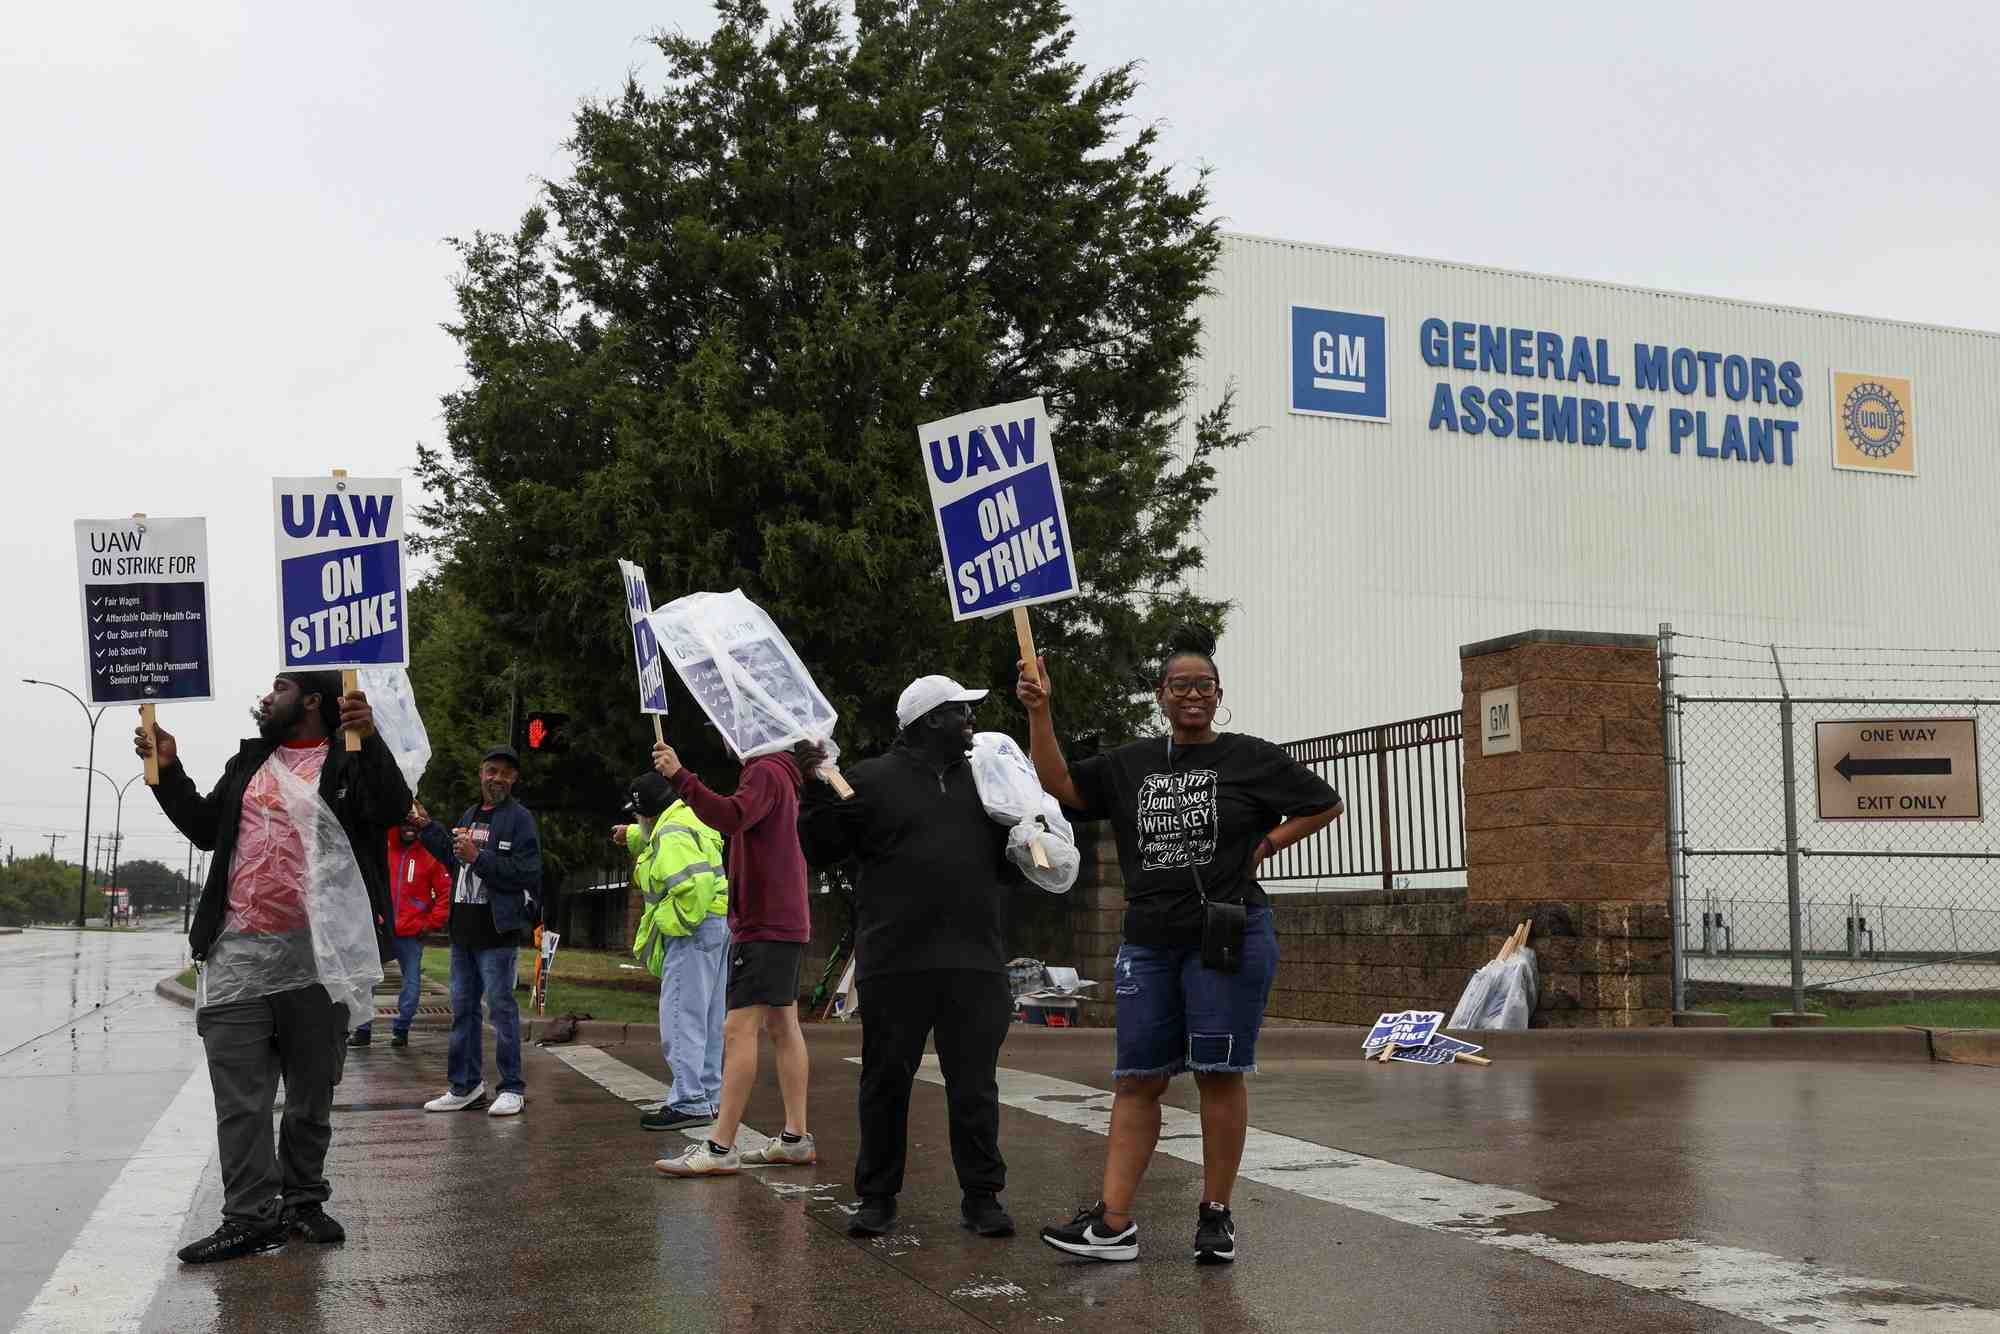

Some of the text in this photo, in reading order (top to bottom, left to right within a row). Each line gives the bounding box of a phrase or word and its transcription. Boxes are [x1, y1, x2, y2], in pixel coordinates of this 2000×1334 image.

[1313, 331, 1365, 377] GM
[1419, 317, 1804, 408] GENERAL MOTORS
[1428, 382, 1800, 466] ASSEMBLY PLANT
[1861, 411, 1888, 429] UAW
[928, 417, 1036, 484] UAW
[281, 494, 393, 539] UAW
[977, 485, 1021, 542] ON
[90, 531, 142, 552] UAW
[92, 555, 196, 576] ON STRIKE FOR
[957, 515, 1062, 605] STRIKE
[321, 554, 363, 602] ON
[104, 596, 140, 606] Fair Wages
[105, 610, 201, 623] Affordable Quality Health Care
[290, 591, 397, 659] STRIKE
[106, 630, 119, 640] Our
[120, 630, 139, 640] Share
[148, 628, 168, 638] Profits
[108, 645, 147, 657] Job Security
[115, 663, 140, 673] Defined
[141, 661, 156, 671] Path
[163, 660, 199, 671] Permanent
[110, 673, 169, 685] Seniority for Temps
[1490, 703, 1510, 731] GM
[1860, 729, 1937, 742] ONE WAY
[1141, 790, 1209, 811] Tennssee
[1857, 796, 1947, 810] EXIT ONLY
[1142, 808, 1210, 833] WHISKEY
[1155, 832, 1186, 842] SWEE
[1143, 839, 1212, 855] Strawbrry
[1157, 849, 1193, 864] Win
[1380, 1013, 1439, 1024] UAW
[1391, 1024, 1415, 1033] ON
[1369, 1031, 1428, 1046] STRIKE
